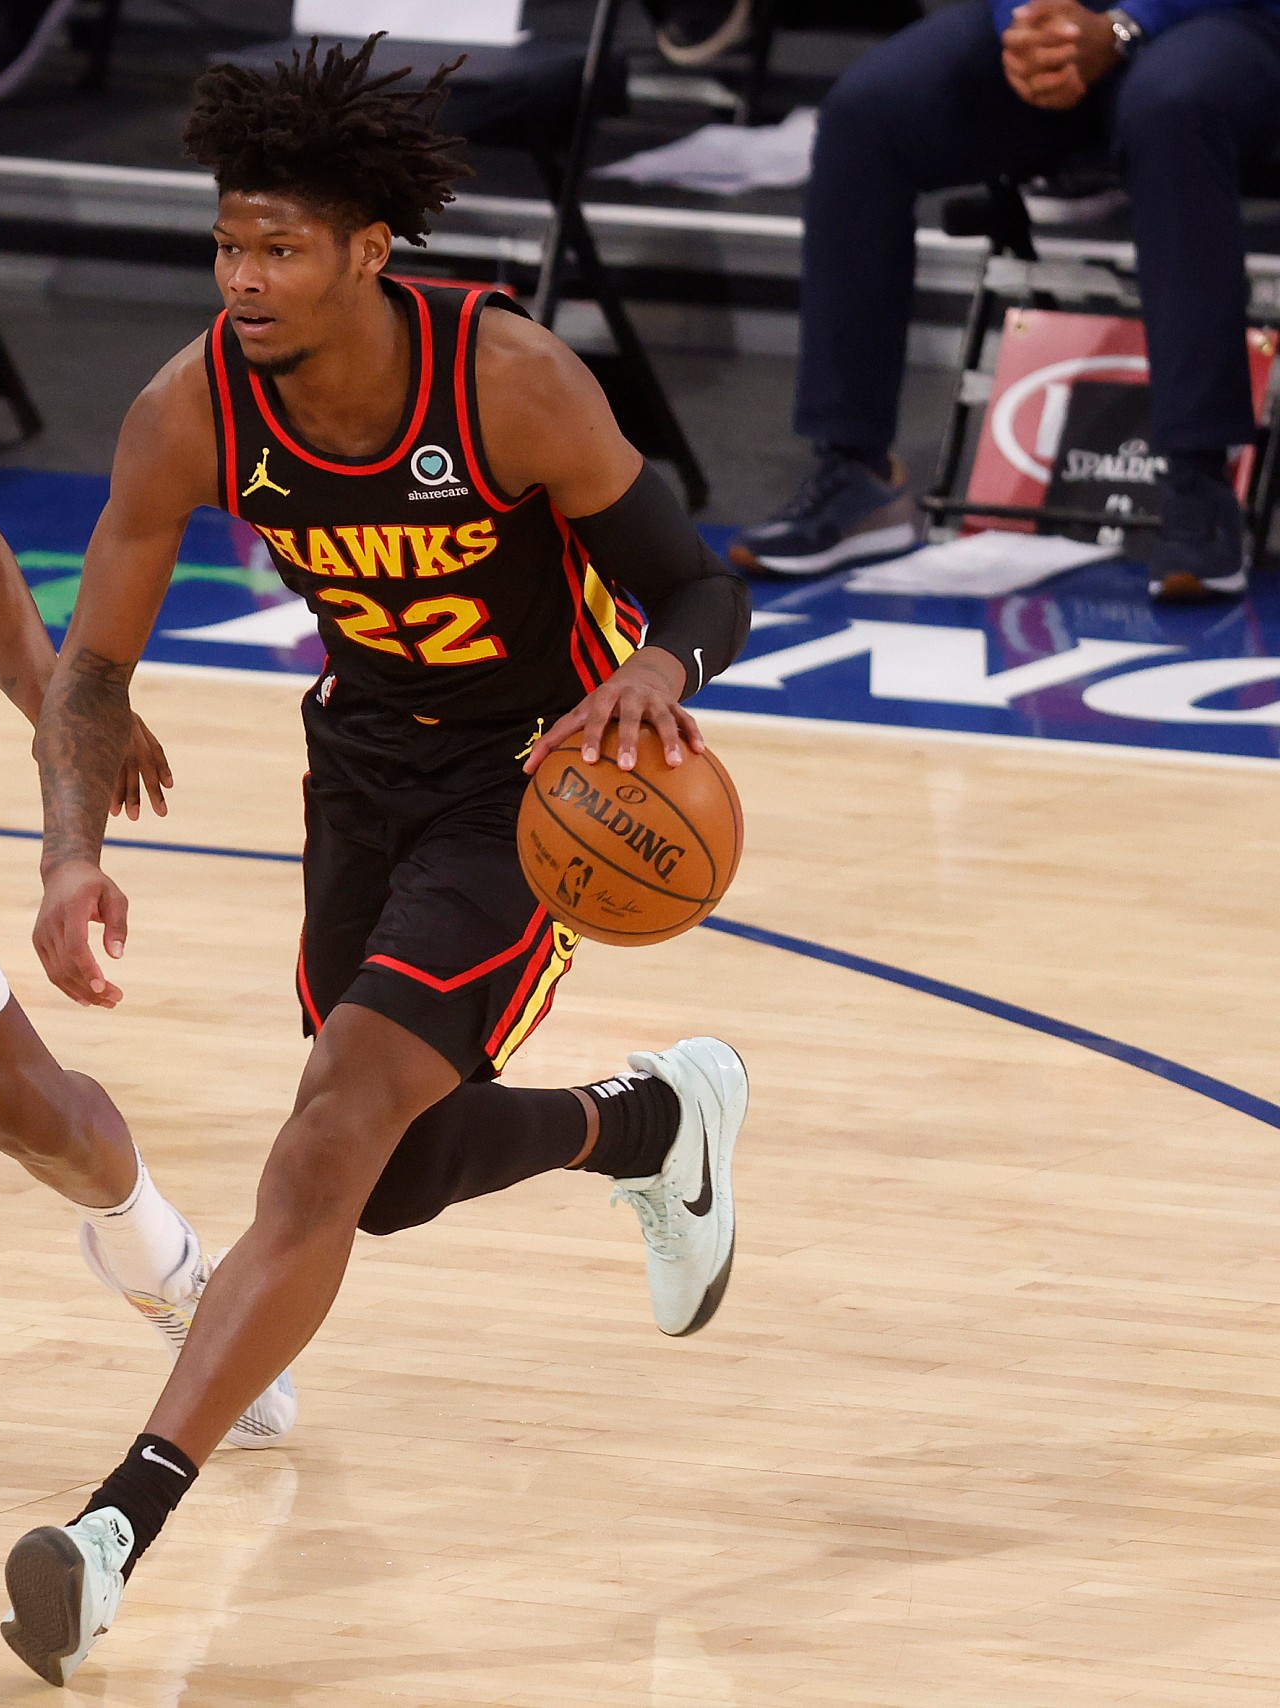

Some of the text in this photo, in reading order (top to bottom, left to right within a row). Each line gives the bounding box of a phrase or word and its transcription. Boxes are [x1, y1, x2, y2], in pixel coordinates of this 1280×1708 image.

[408, 485, 469, 501] sharecare
[249, 517, 499, 580] HAWKS
[315, 586, 508, 667] 22
[548, 765, 686, 880] SPALDING
